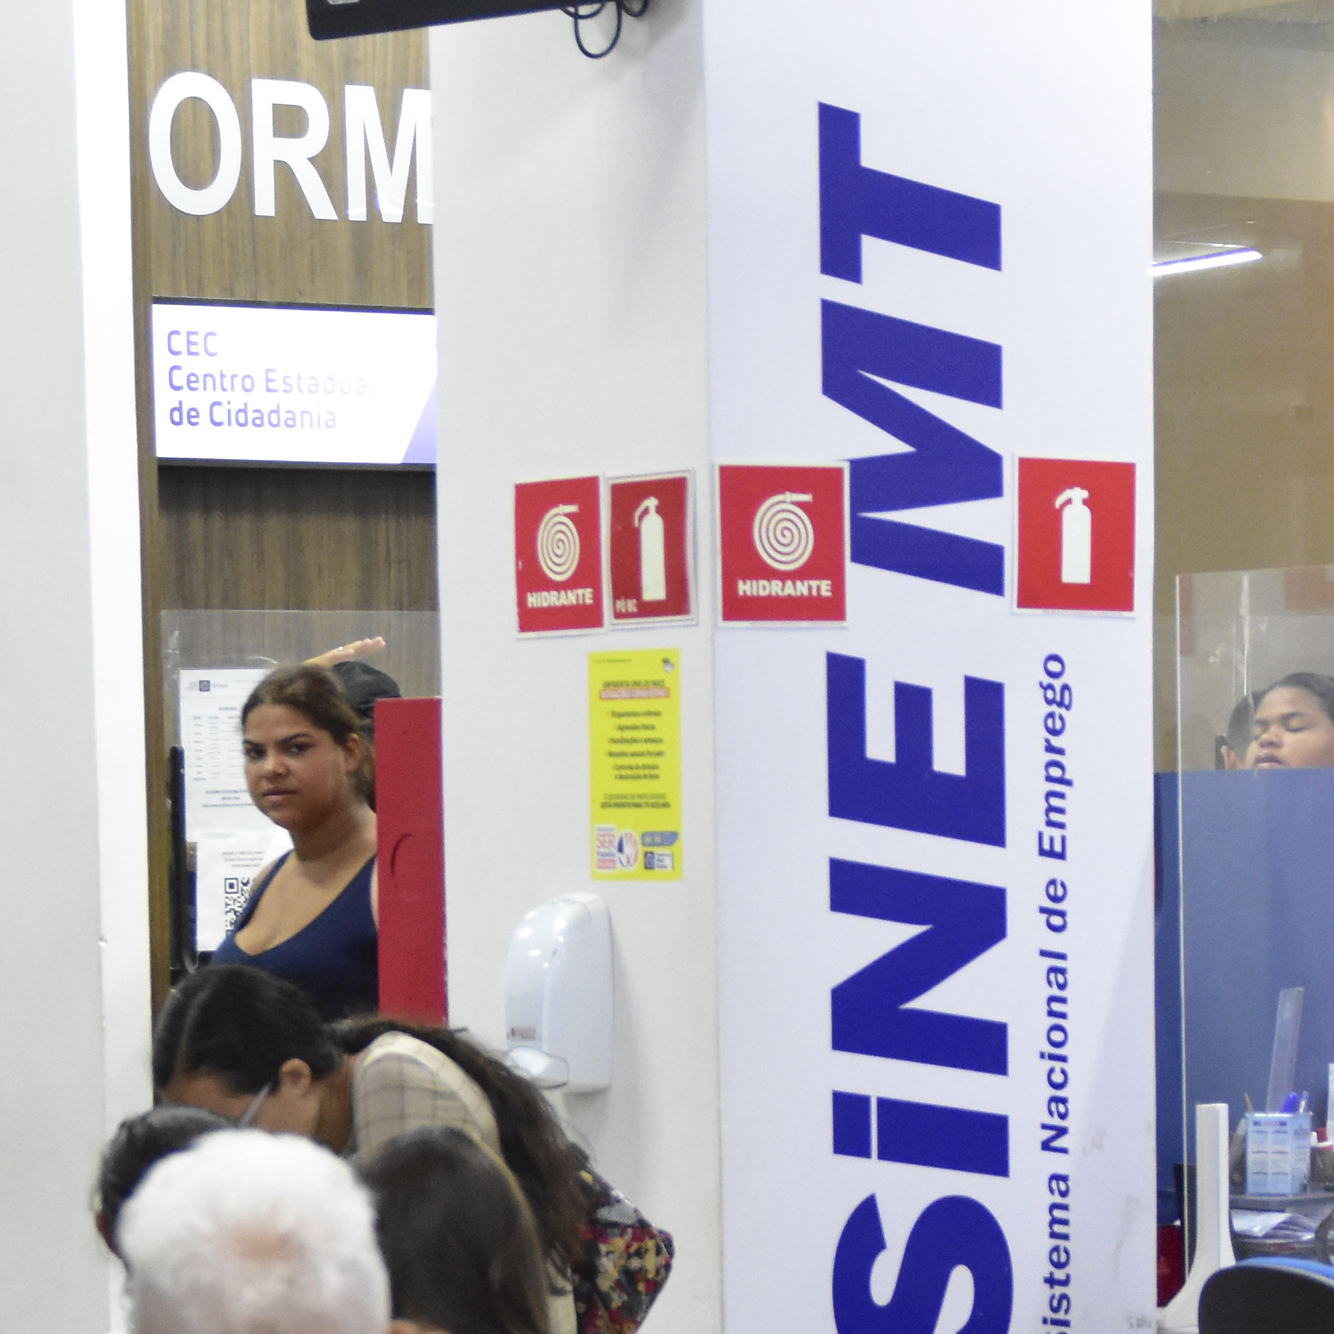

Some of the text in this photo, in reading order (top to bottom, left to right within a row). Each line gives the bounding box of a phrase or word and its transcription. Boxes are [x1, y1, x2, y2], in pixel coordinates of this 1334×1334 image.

[167, 329, 218, 357] CEC
[818, 100, 1006, 598] MT
[168, 364, 376, 395] Centro Estadual
[169, 400, 337, 429] de Cidadania
[526, 587, 595, 609] HIDRANTE
[737, 579, 833, 597] HIDRANTE
[1037, 652, 1074, 861] Emprego
[1038, 877, 1069, 934] de
[1039, 949, 1071, 1155] Nacional
